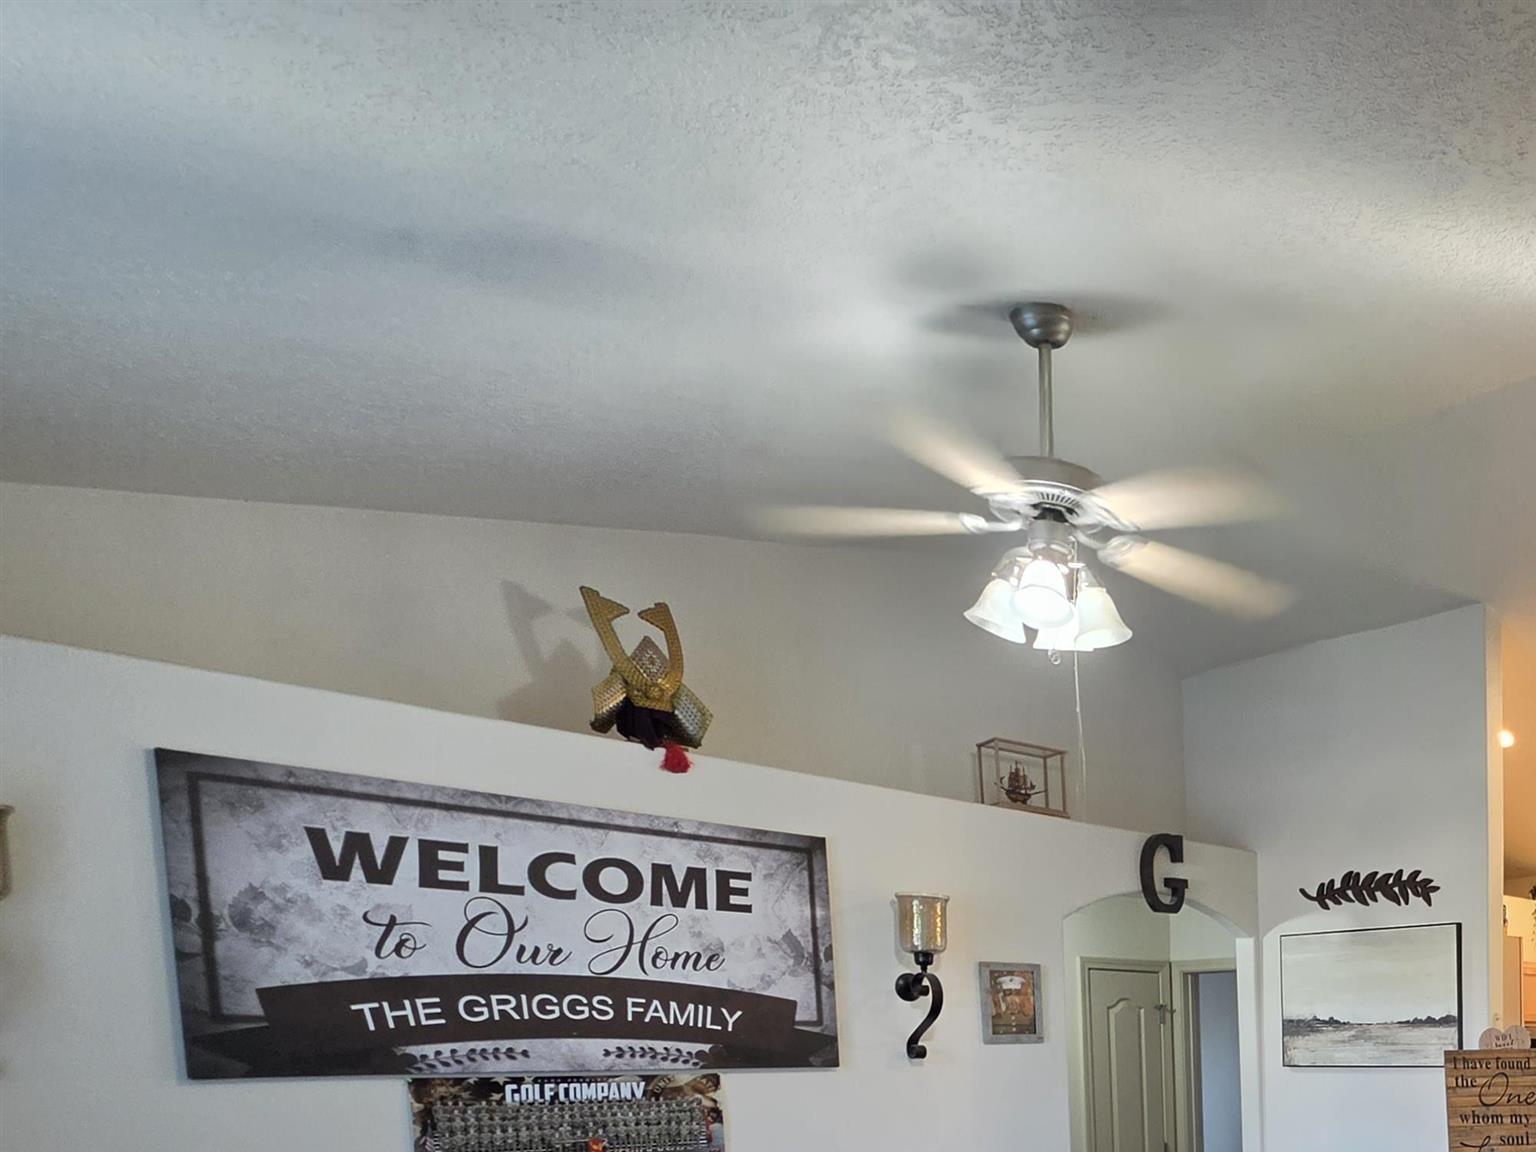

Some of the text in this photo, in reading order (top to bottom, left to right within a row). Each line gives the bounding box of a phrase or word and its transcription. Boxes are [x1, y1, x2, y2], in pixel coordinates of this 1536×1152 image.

[303, 825, 753, 914] WELCOME
[1140, 833, 1189, 914] G
[362, 896, 727, 976] to Our Home
[350, 993, 743, 1032] THE GRIGGS FAMILY
[1453, 1055, 1532, 1070] I have found
[504, 1080, 646, 1104] GOLF COMPANY
[1455, 1074, 1478, 1089] the
[1459, 1110, 1532, 1128] whom my
[1499, 1130, 1531, 1146] soul
